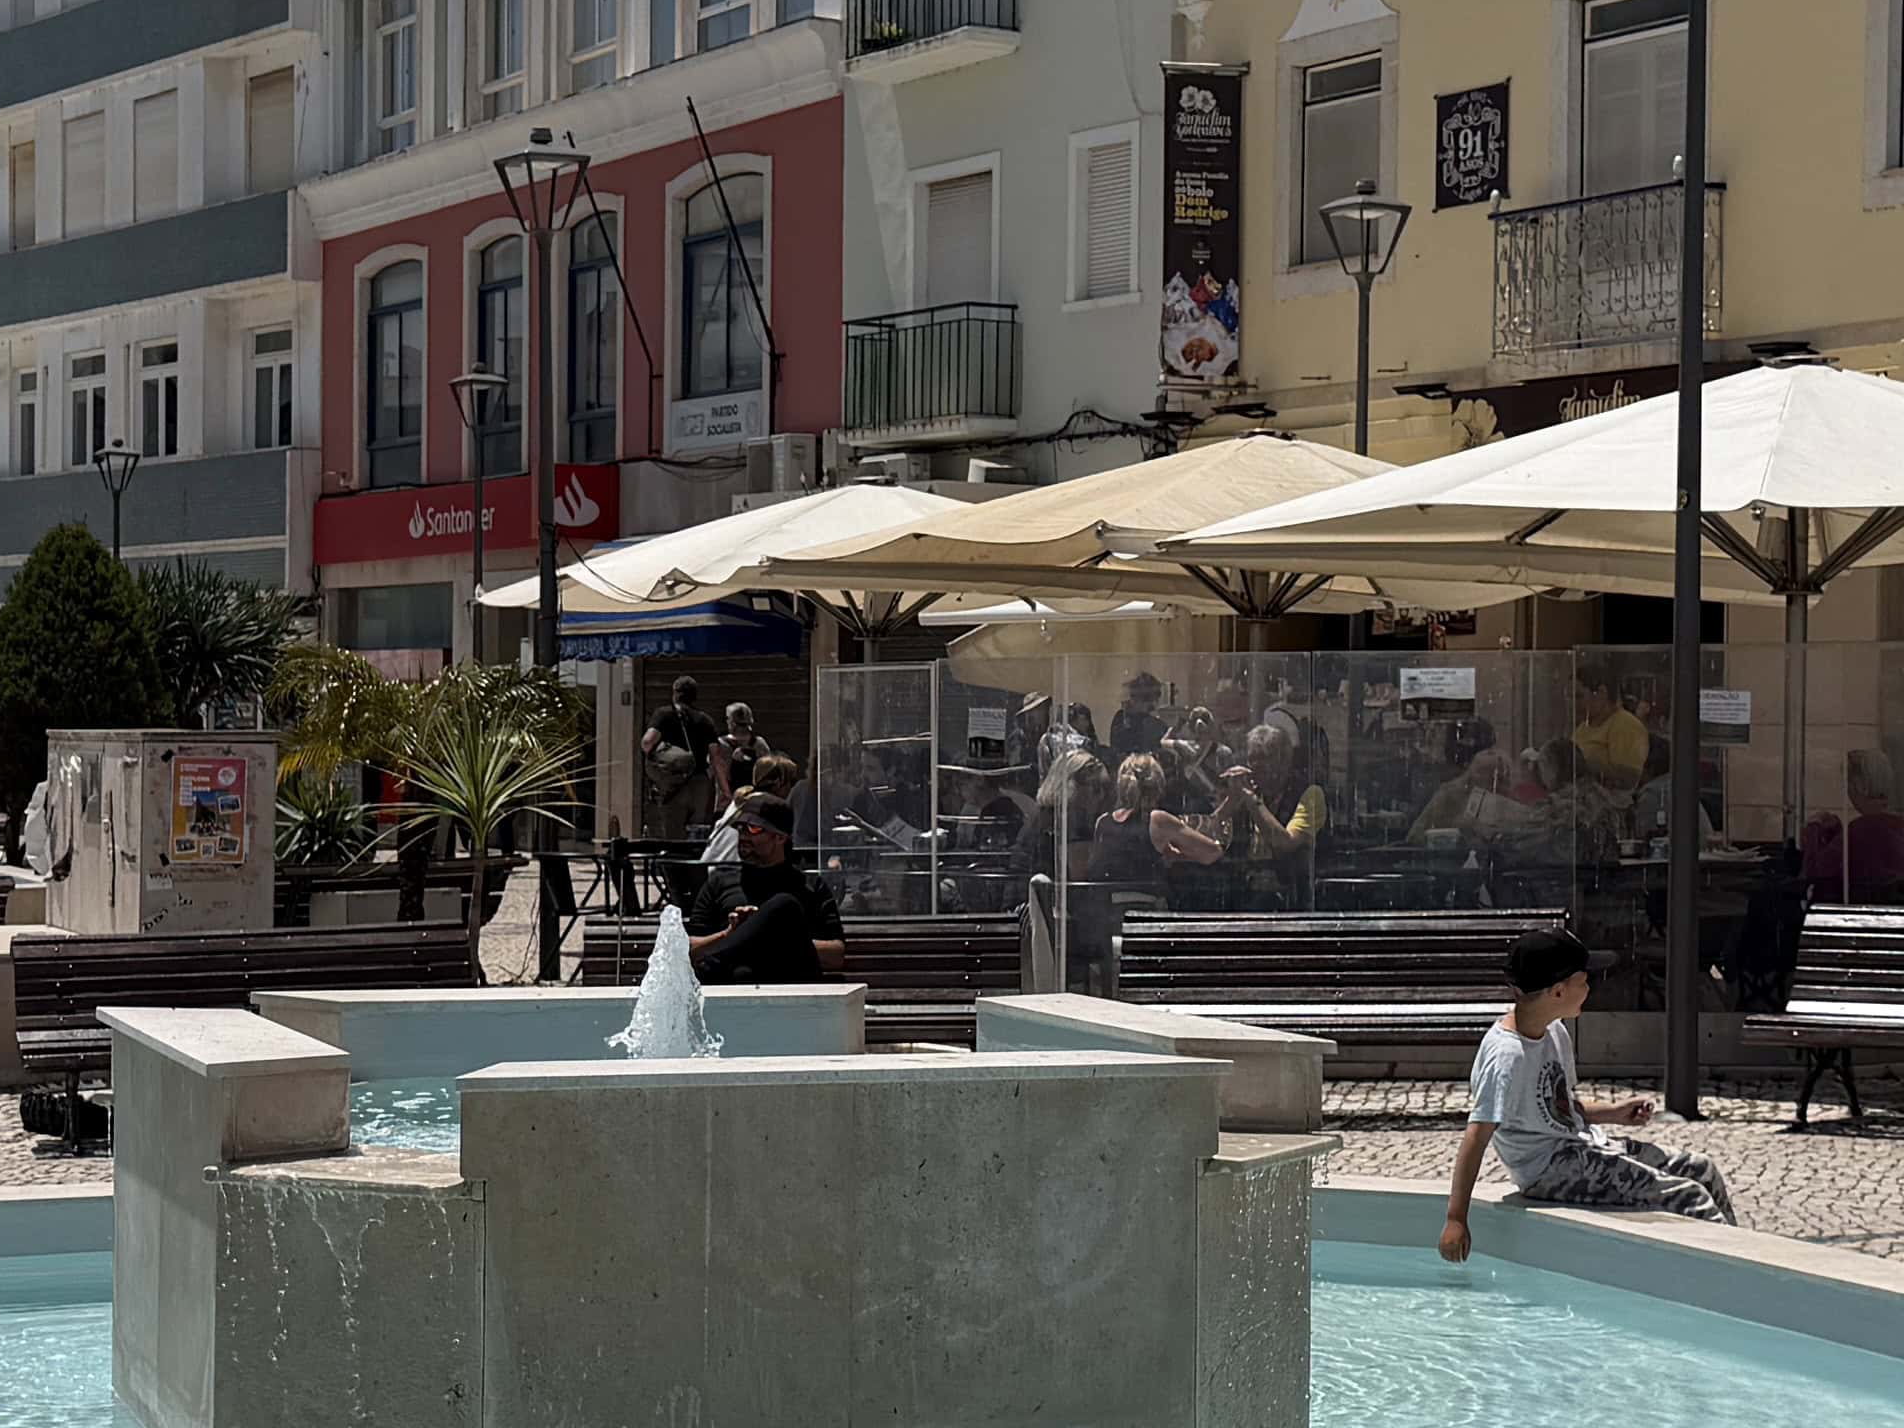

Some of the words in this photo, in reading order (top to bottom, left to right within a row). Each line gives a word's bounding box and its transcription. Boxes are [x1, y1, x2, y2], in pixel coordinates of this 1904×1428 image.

[1459, 128, 1484, 160] 91
[1187, 184, 1214, 197] bolo
[1175, 194, 1209, 206] Dom
[1175, 205, 1229, 221] Rodrigo
[426, 504, 495, 537] Santaner
